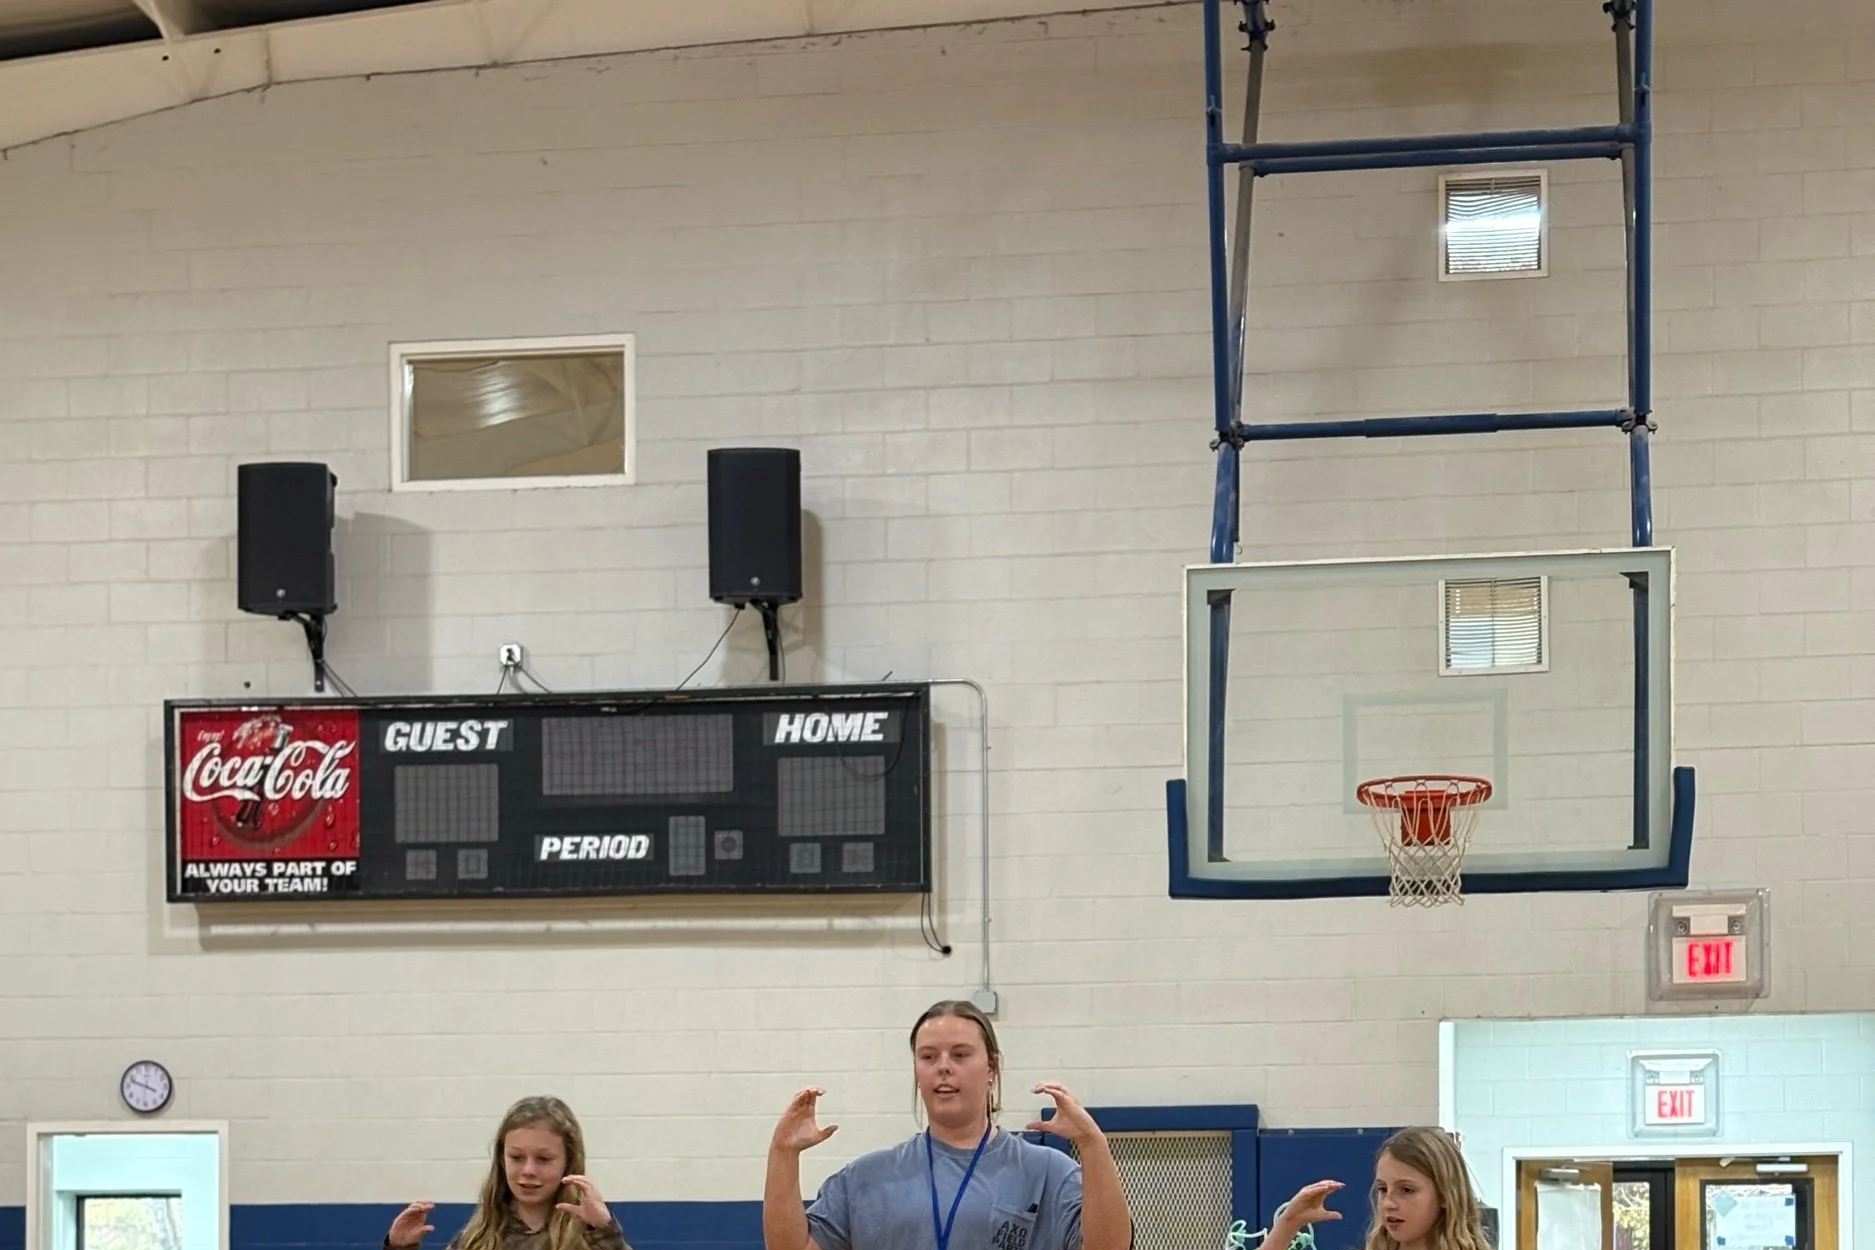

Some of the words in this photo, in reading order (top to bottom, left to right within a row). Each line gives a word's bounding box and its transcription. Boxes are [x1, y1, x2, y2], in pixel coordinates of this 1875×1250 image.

[384, 719, 509, 752] GUEST
[774, 711, 889, 743] HOME
[182, 740, 356, 802] Coca-Cola
[539, 834, 650, 861] PERIOD
[184, 862, 267, 878] ALWAYS
[272, 862, 326, 877] PART
[330, 861, 357, 876] OF
[206, 878, 260, 893] YOUR
[264, 877, 328, 892] TEAM!
[1687, 941, 1733, 978] EXIT
[1657, 1089, 1695, 1118] EXIT
[997, 1228, 1026, 1248] FIELD
